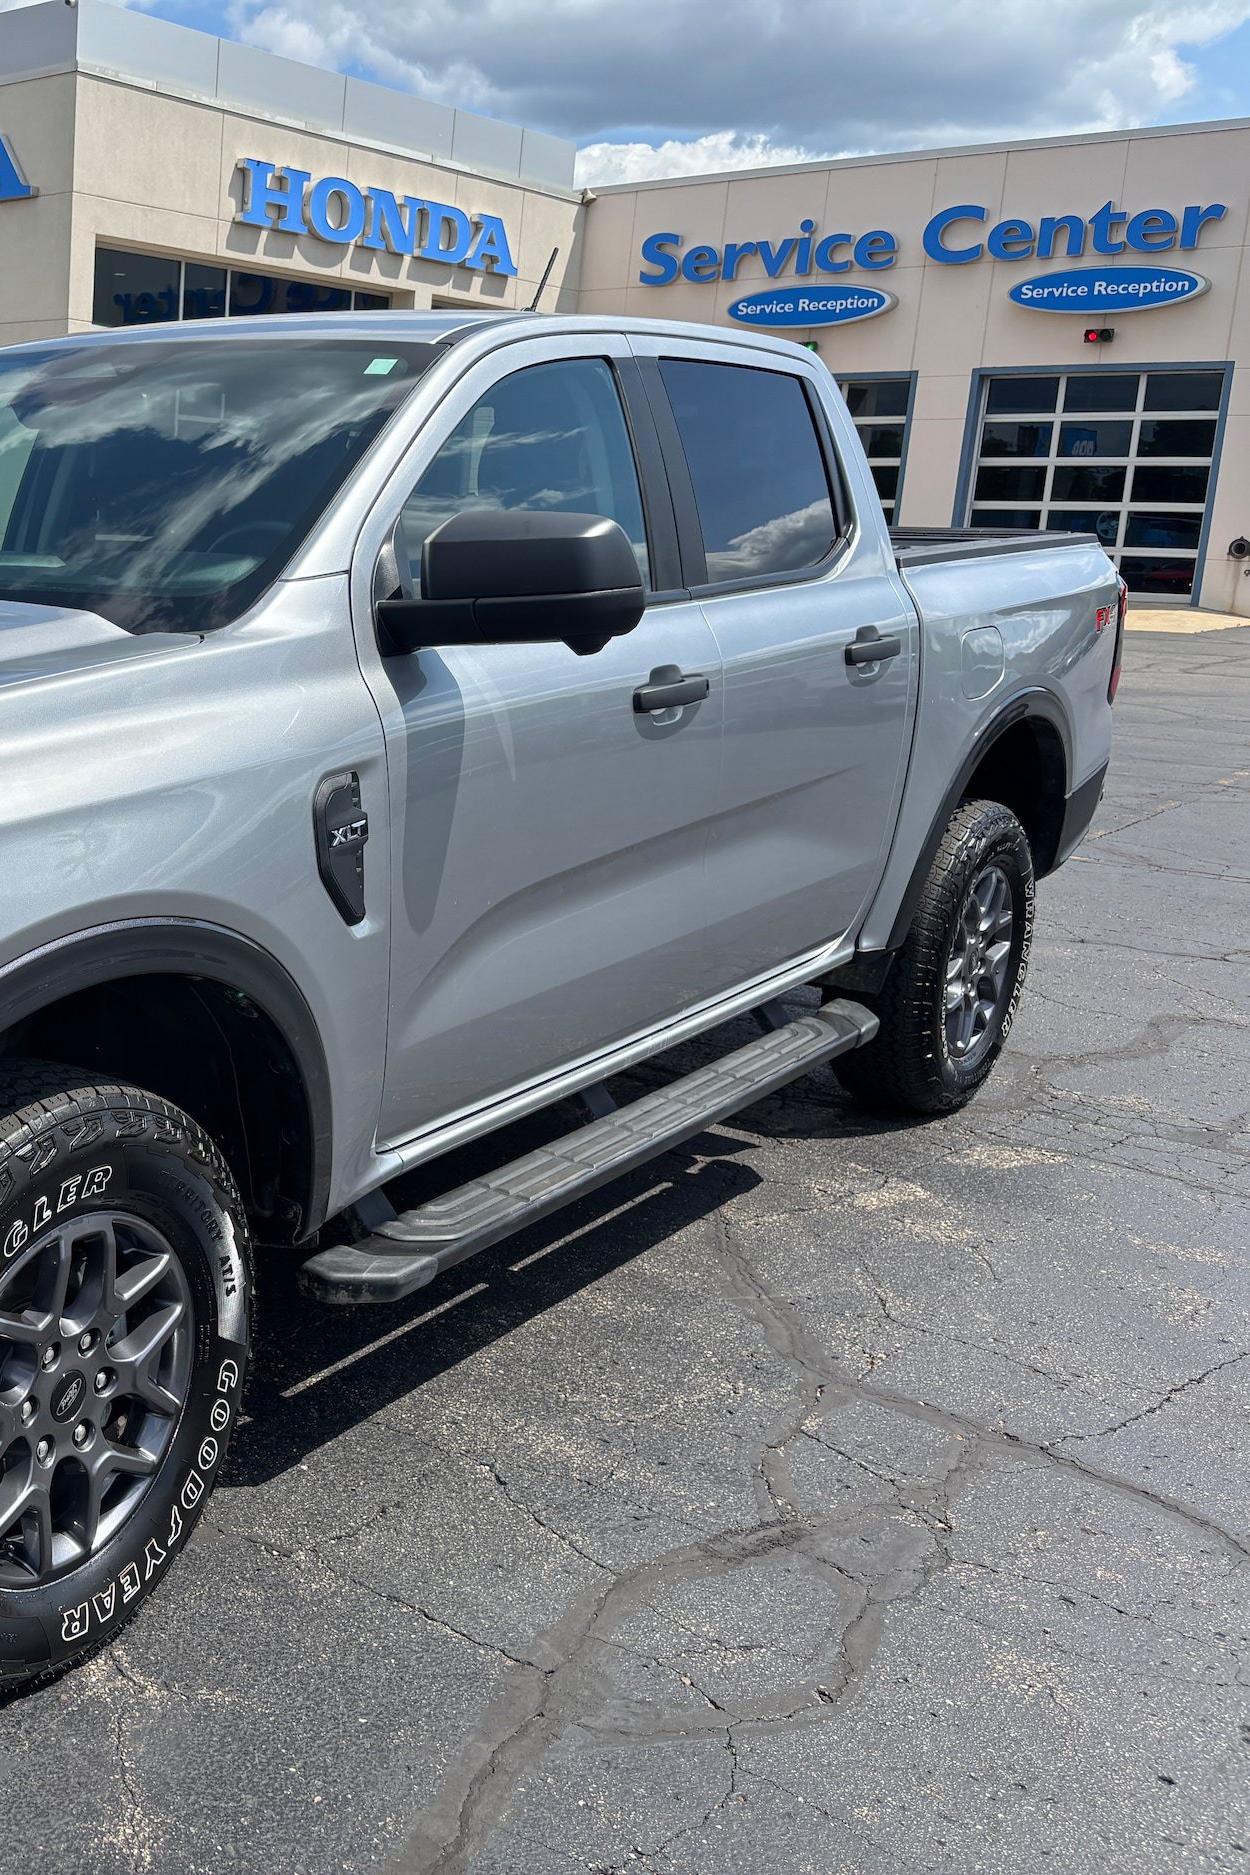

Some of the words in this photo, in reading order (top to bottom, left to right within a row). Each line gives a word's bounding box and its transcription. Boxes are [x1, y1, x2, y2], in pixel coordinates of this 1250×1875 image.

[237, 158, 518, 276] HONDA
[639, 219, 898, 286] Service
[922, 200, 1228, 264] Center
[737, 301, 794, 316] Service
[798, 296, 878, 314] Reception
[1020, 282, 1088, 299] Service
[1093, 278, 1190, 297] Reception
[331, 819, 367, 846] XLT
[1001, 877, 1036, 1037] WRANGLER
[61, 1359, 239, 1642] GOODYEAR
